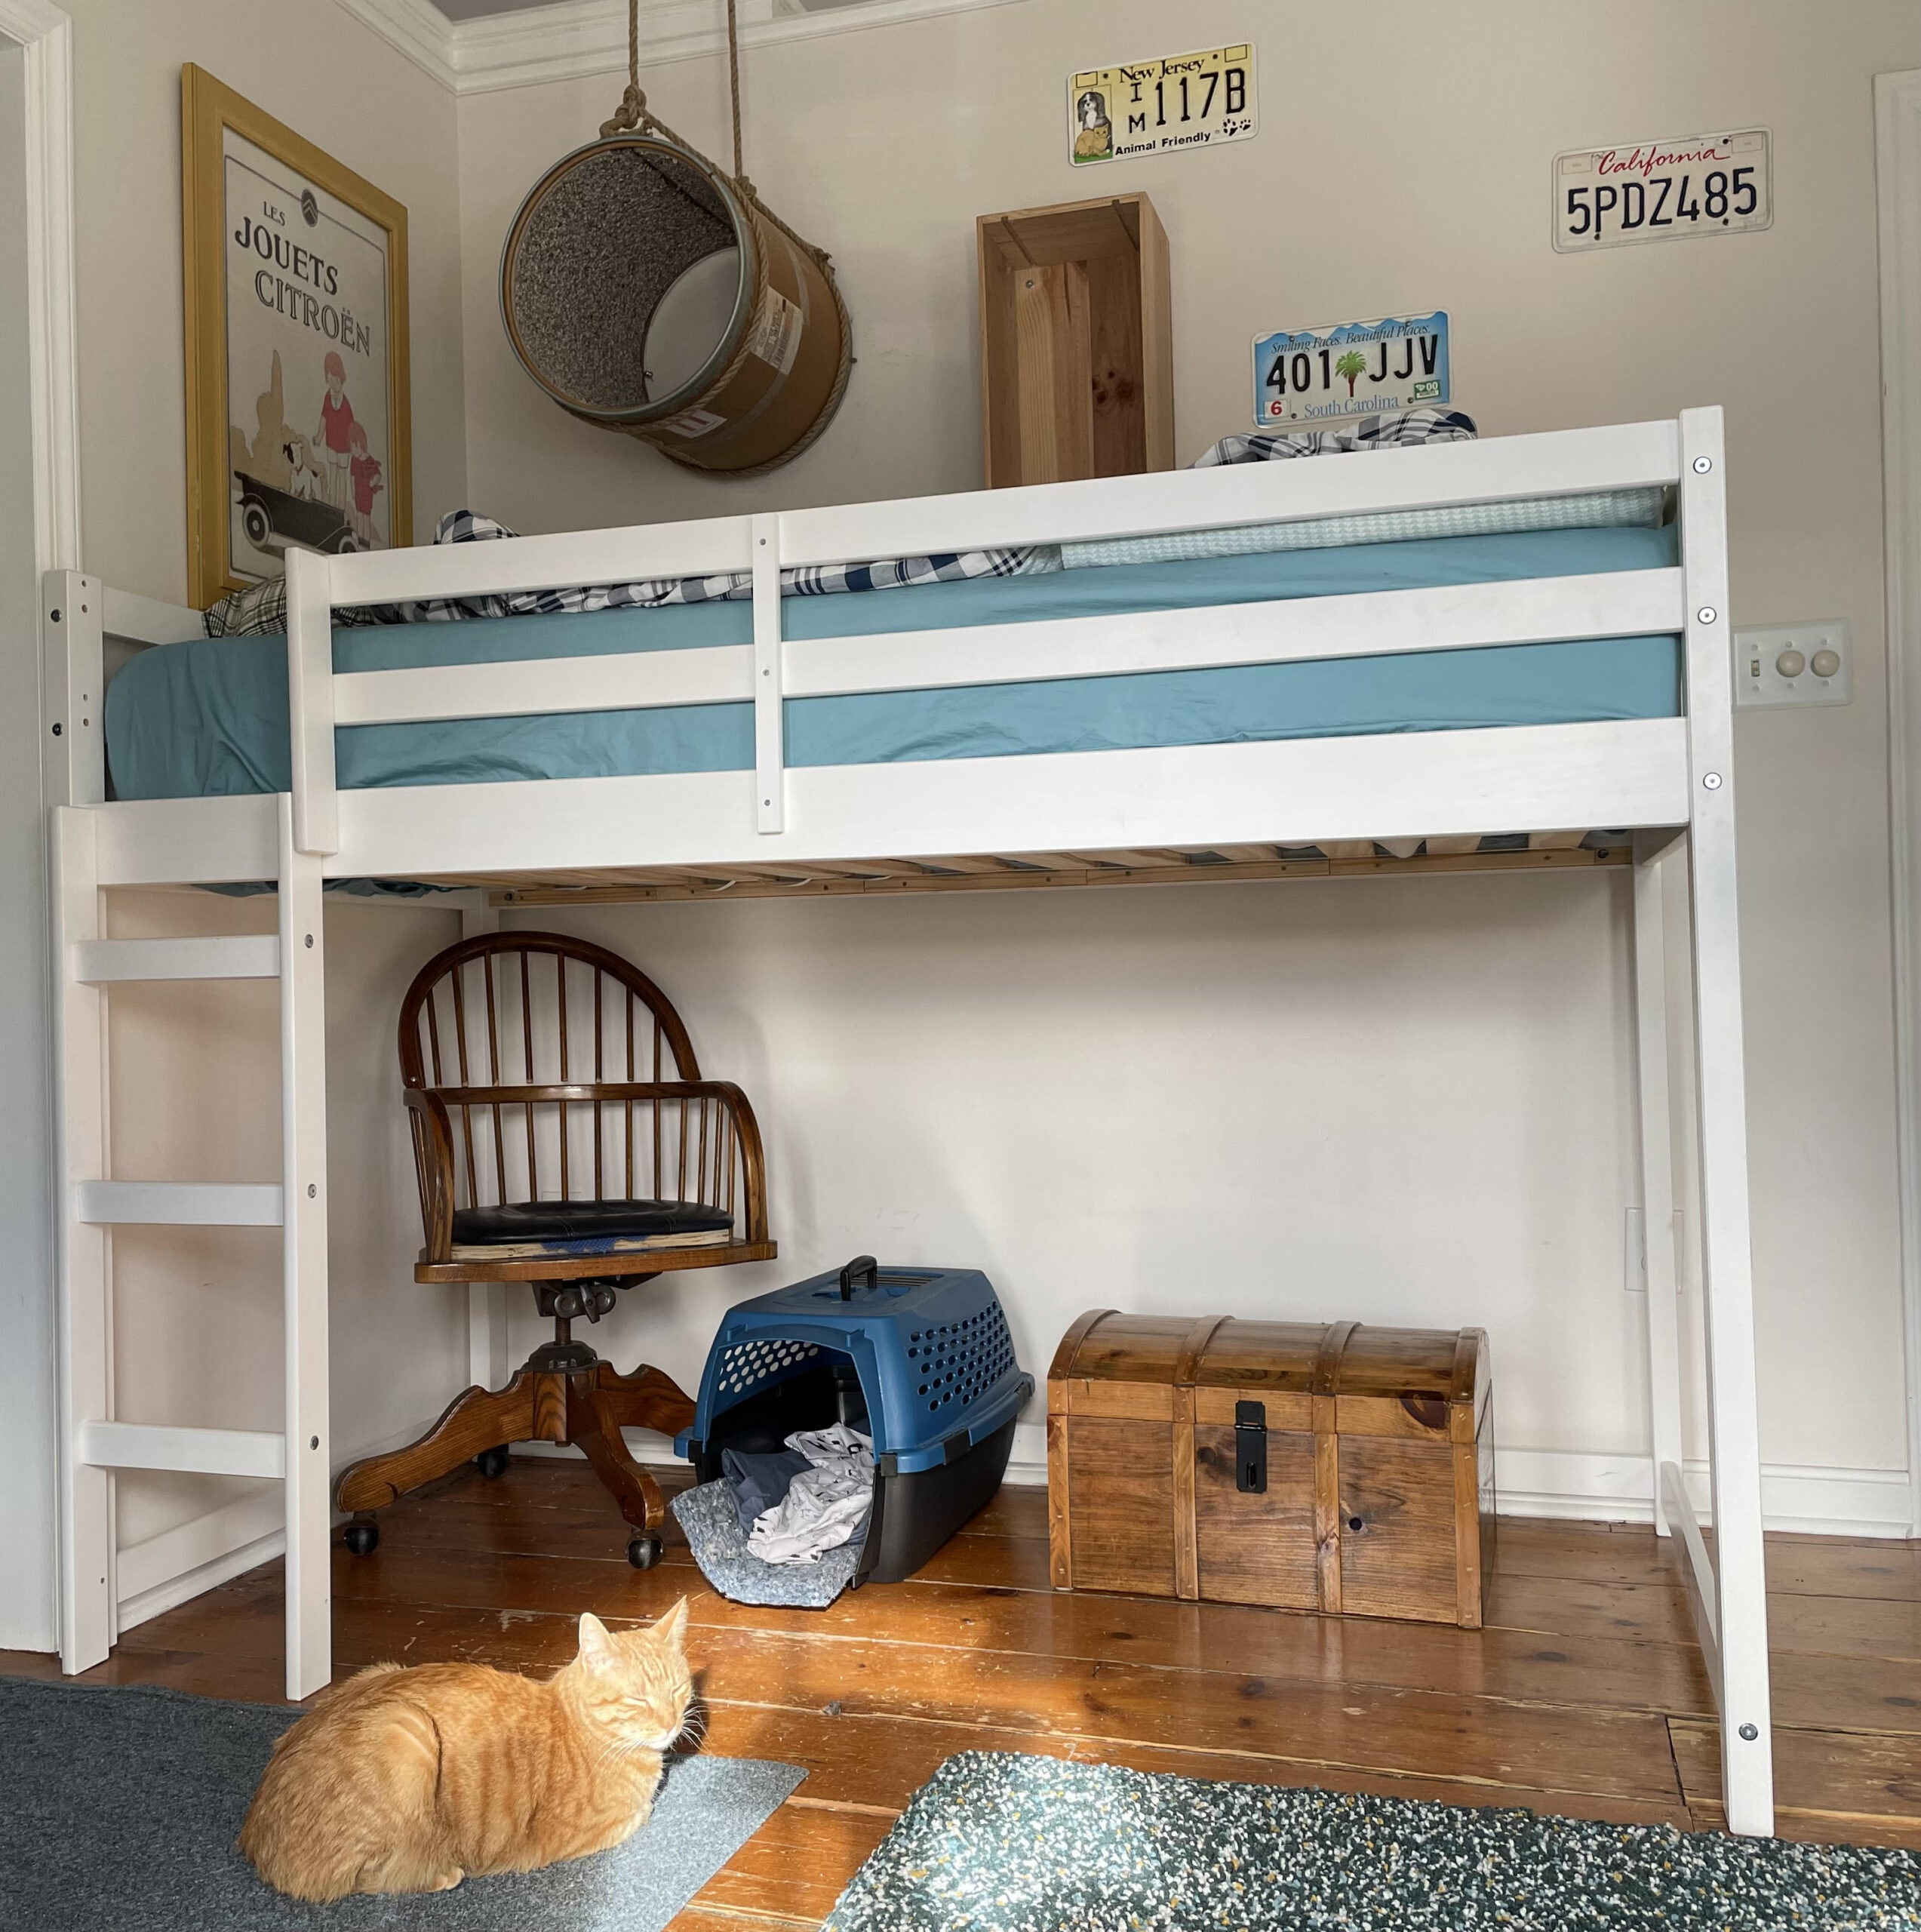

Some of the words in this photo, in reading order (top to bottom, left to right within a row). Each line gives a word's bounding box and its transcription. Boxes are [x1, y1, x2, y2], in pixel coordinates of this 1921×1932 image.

[1119, 66, 1155, 83] New
[1159, 59, 1205, 79] Jersey
[1155, 68, 1246, 127] 117B
[1115, 140, 1156, 155] Animal
[1161, 131, 1211, 148] Friendly
[1598, 146, 1731, 177] California
[263, 201, 285, 226] LES
[1567, 167, 1757, 235] 5PDZ485
[235, 216, 339, 296] JOUETS
[254, 269, 370, 357] CITROËN
[1271, 339, 1311, 354] Smiling
[1313, 336, 1342, 348] Faces.
[1346, 327, 1395, 344] Beautiful
[1397, 324, 1431, 338] Places.
[1266, 349, 1331, 395] 401
[1369, 334, 1438, 383] JJV
[1426, 381, 1438, 391] 00
[1271, 401, 1283, 416] 6
[1305, 398, 1341, 419] South
[1345, 395, 1399, 412] Carolina
